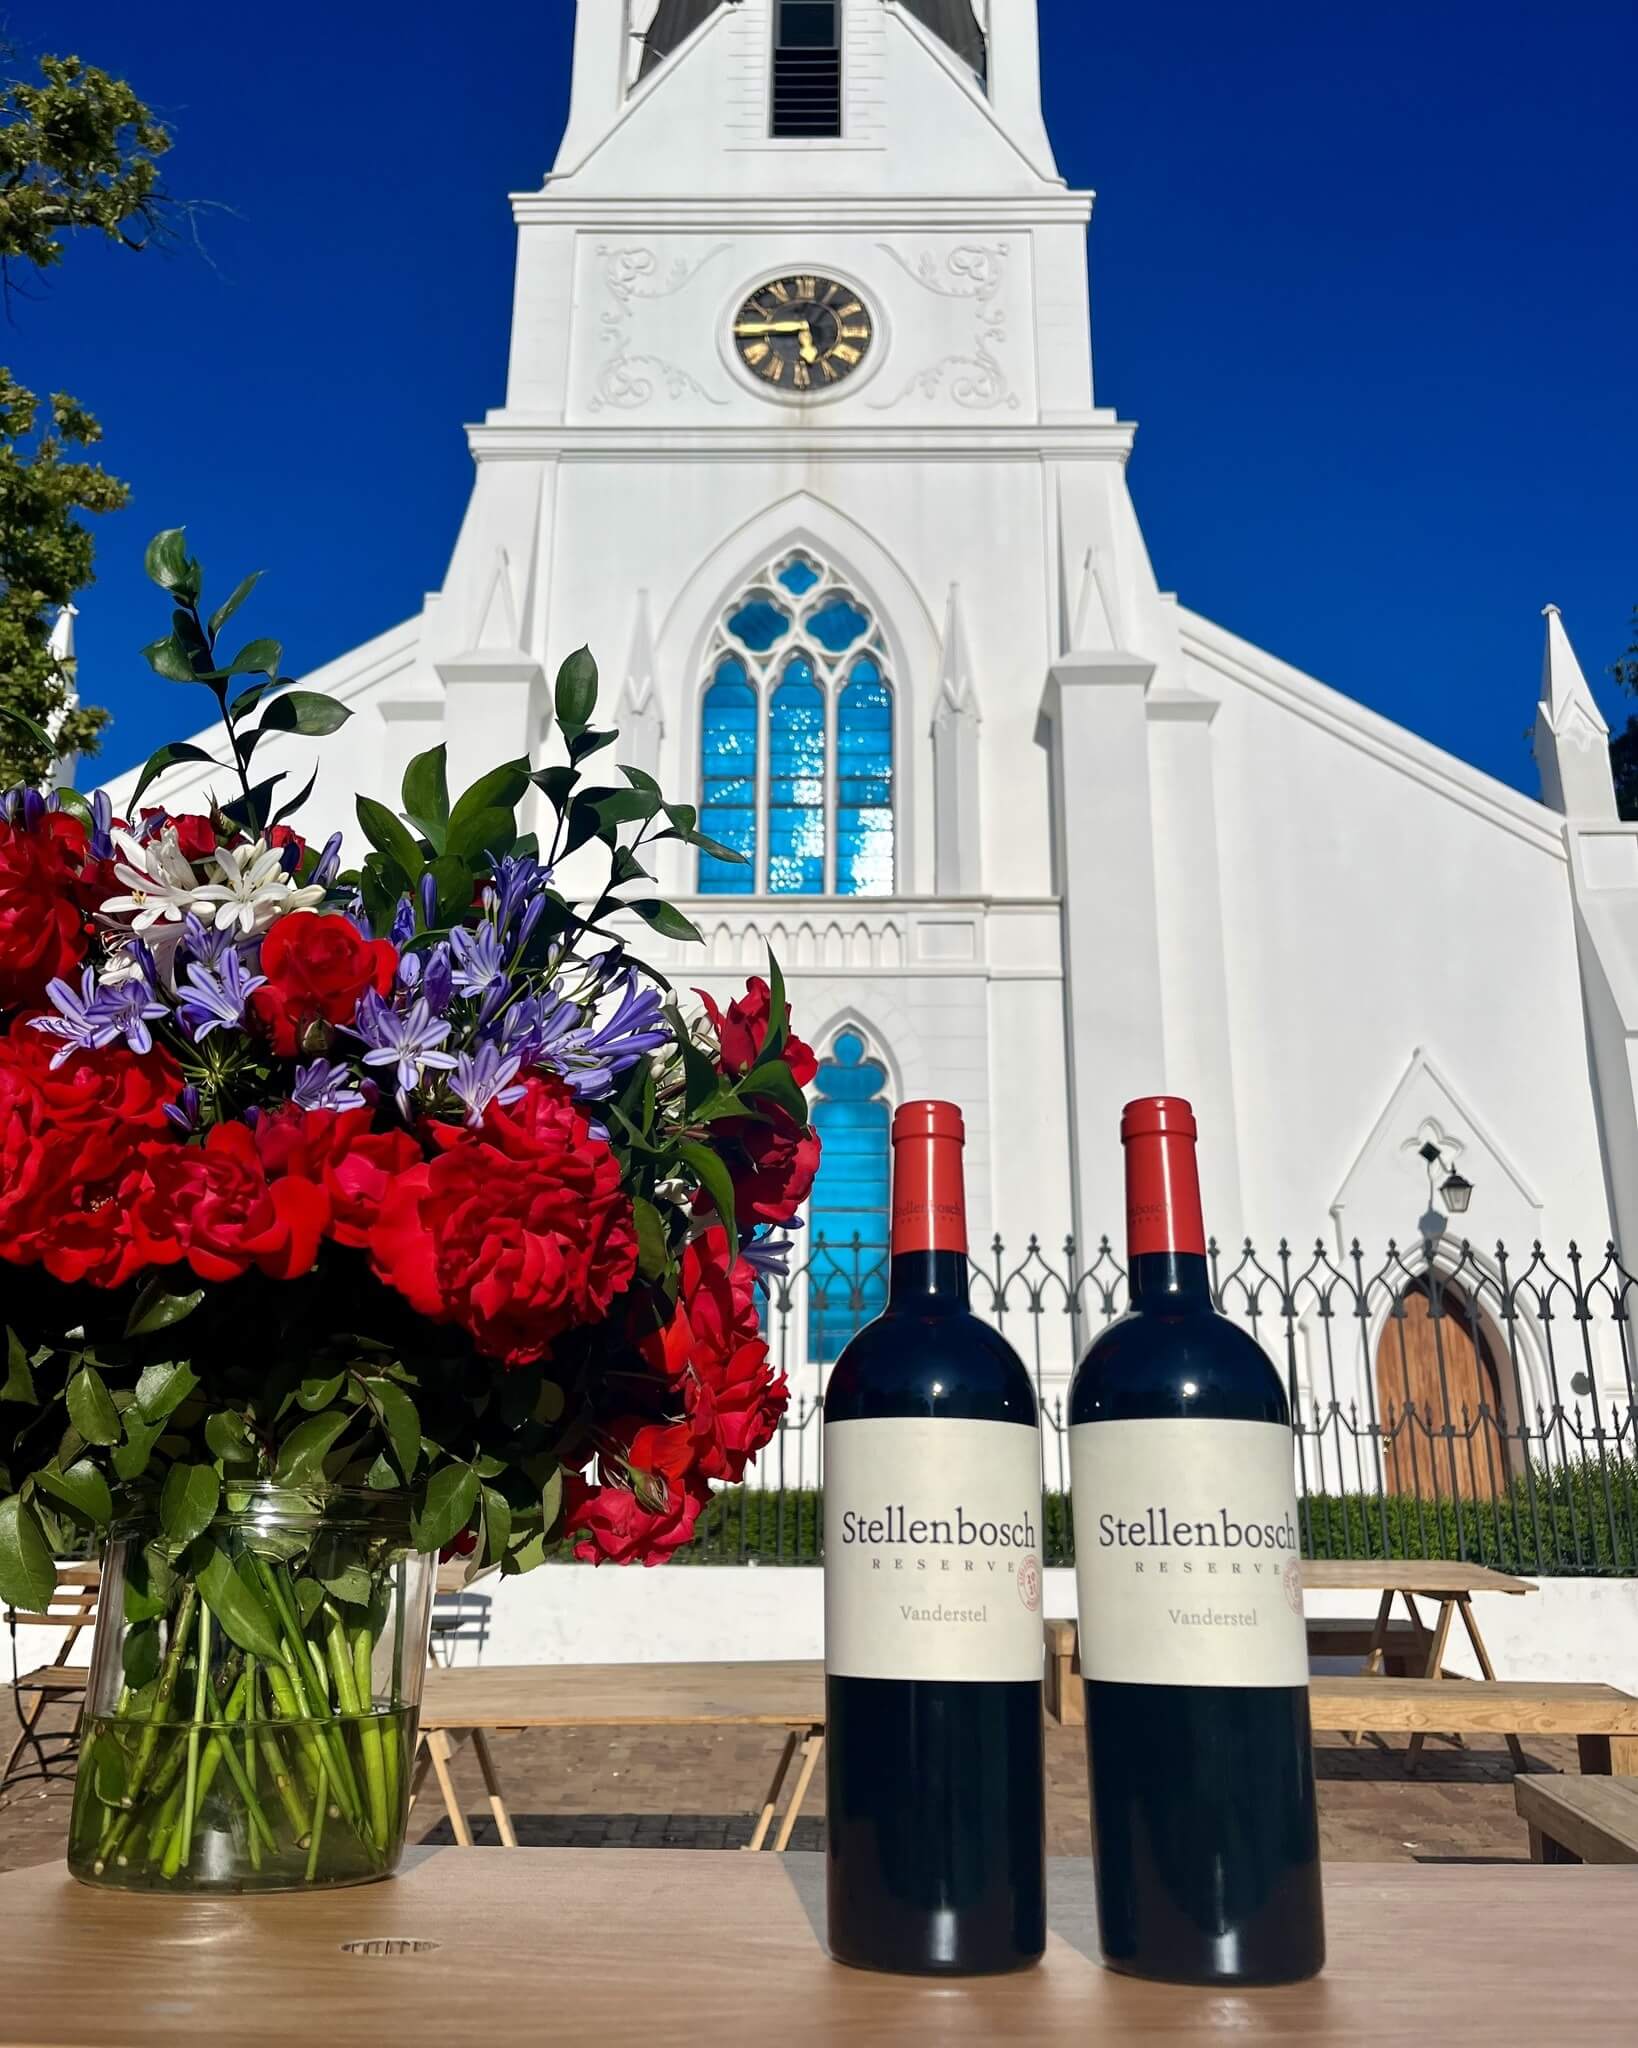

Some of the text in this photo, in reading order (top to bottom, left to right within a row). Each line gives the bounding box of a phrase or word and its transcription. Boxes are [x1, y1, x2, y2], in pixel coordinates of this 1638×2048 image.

[842, 1504, 1036, 1548] Stellenbosch
[1099, 1507, 1297, 1550] Stellenbosch
[871, 1558, 1015, 1573] RESERVE
[1135, 1561, 1282, 1576] RESERVE
[899, 1605, 987, 1623] Vanderstel
[1168, 1608, 1258, 1627] Vanderstel
